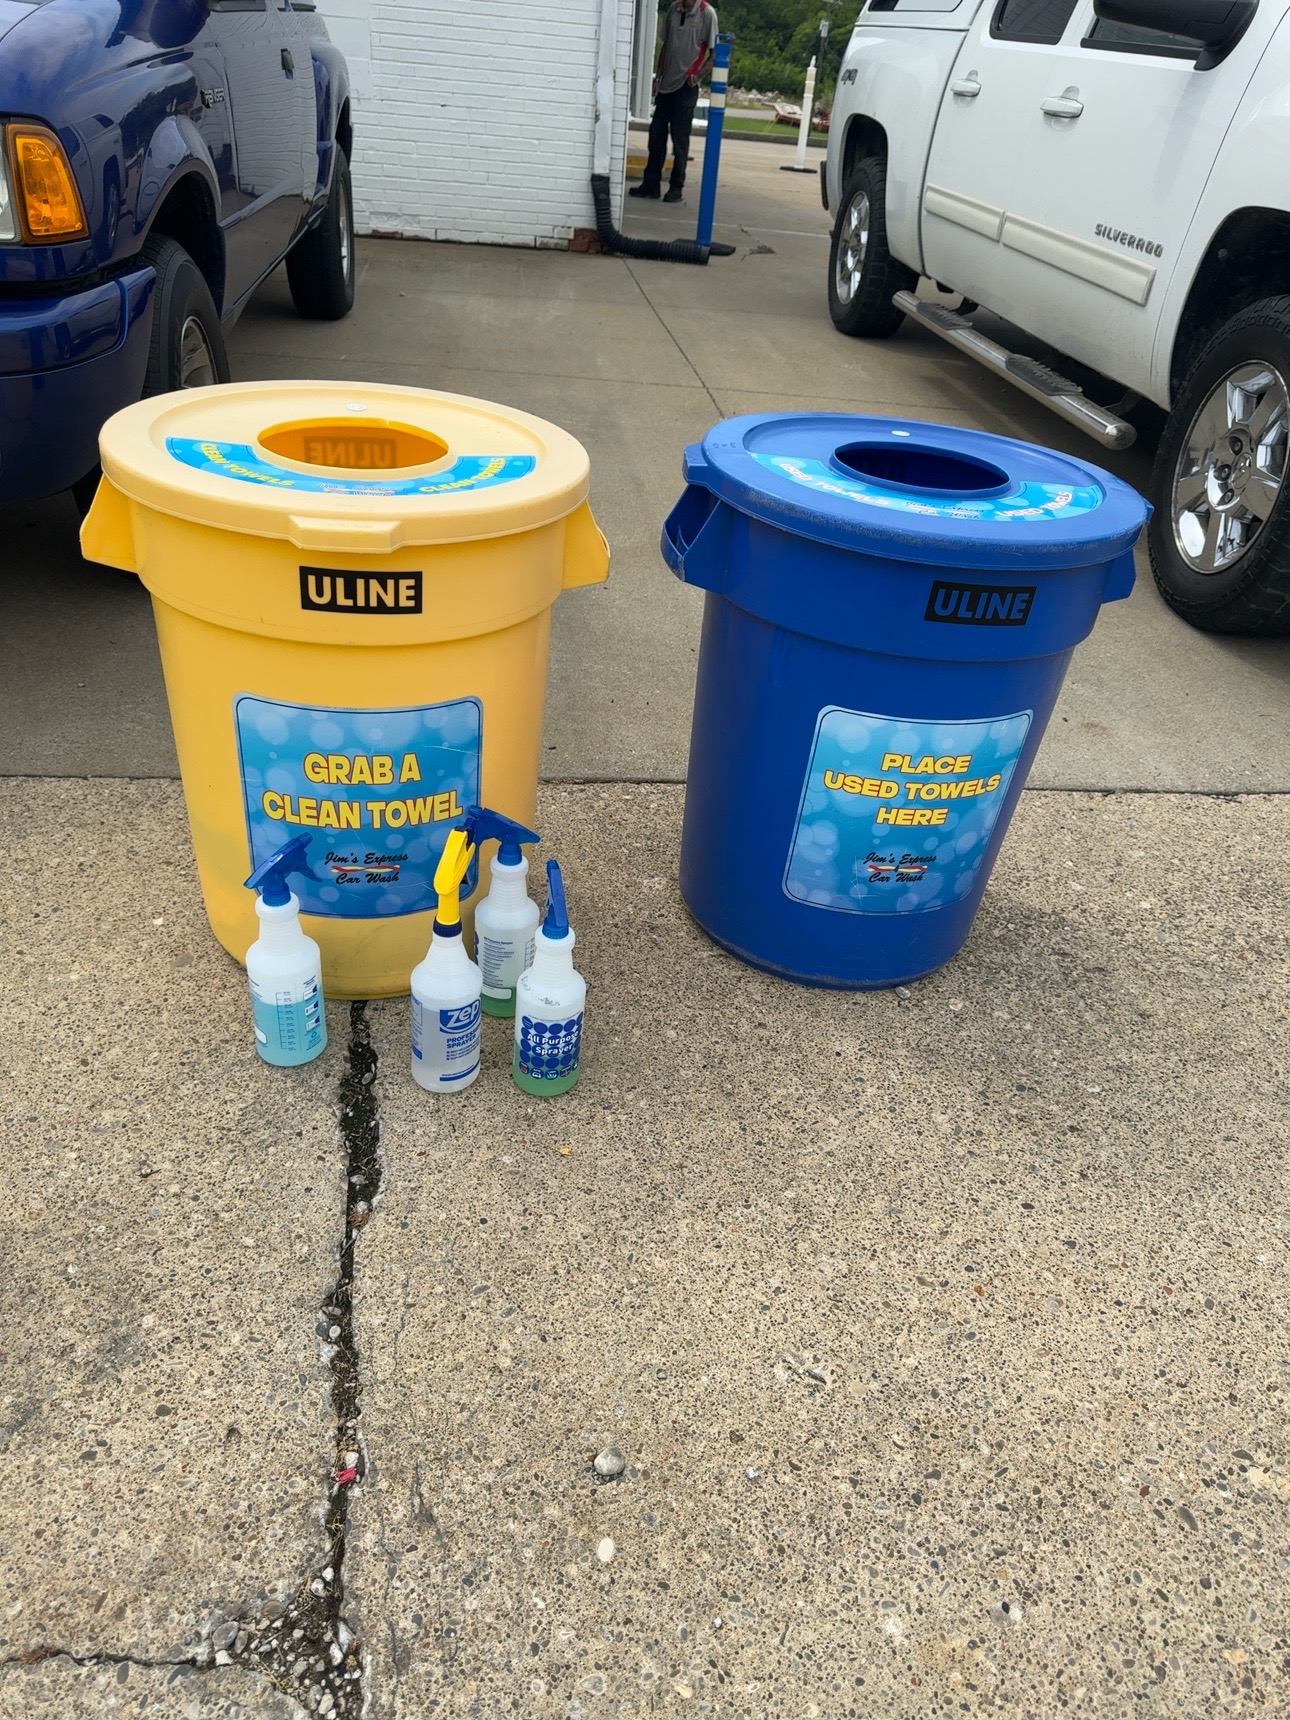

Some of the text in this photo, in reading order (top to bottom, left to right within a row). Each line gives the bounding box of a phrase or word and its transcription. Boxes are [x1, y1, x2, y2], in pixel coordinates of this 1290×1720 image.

[1094, 223, 1164, 258] SILVERADO
[307, 574, 417, 608] ULINE
[934, 588, 1028, 621] ULINE
[303, 752, 421, 785] GRAB A
[881, 753, 972, 774] PLACE
[823, 769, 1002, 801] USED TOWELS
[262, 790, 463, 830] CLEAN TOWEL
[875, 806, 949, 826] HERE
[324, 852, 409, 867] Jim's Express
[863, 852, 937, 866] Jim's Express
[335, 872, 400, 885] Car Wash
[868, 871, 926, 883] Car Wash
[447, 1033, 476, 1049] SPRAYER
[527, 1030, 579, 1046] All Purpose
[536, 1043, 573, 1055] Sprayer
